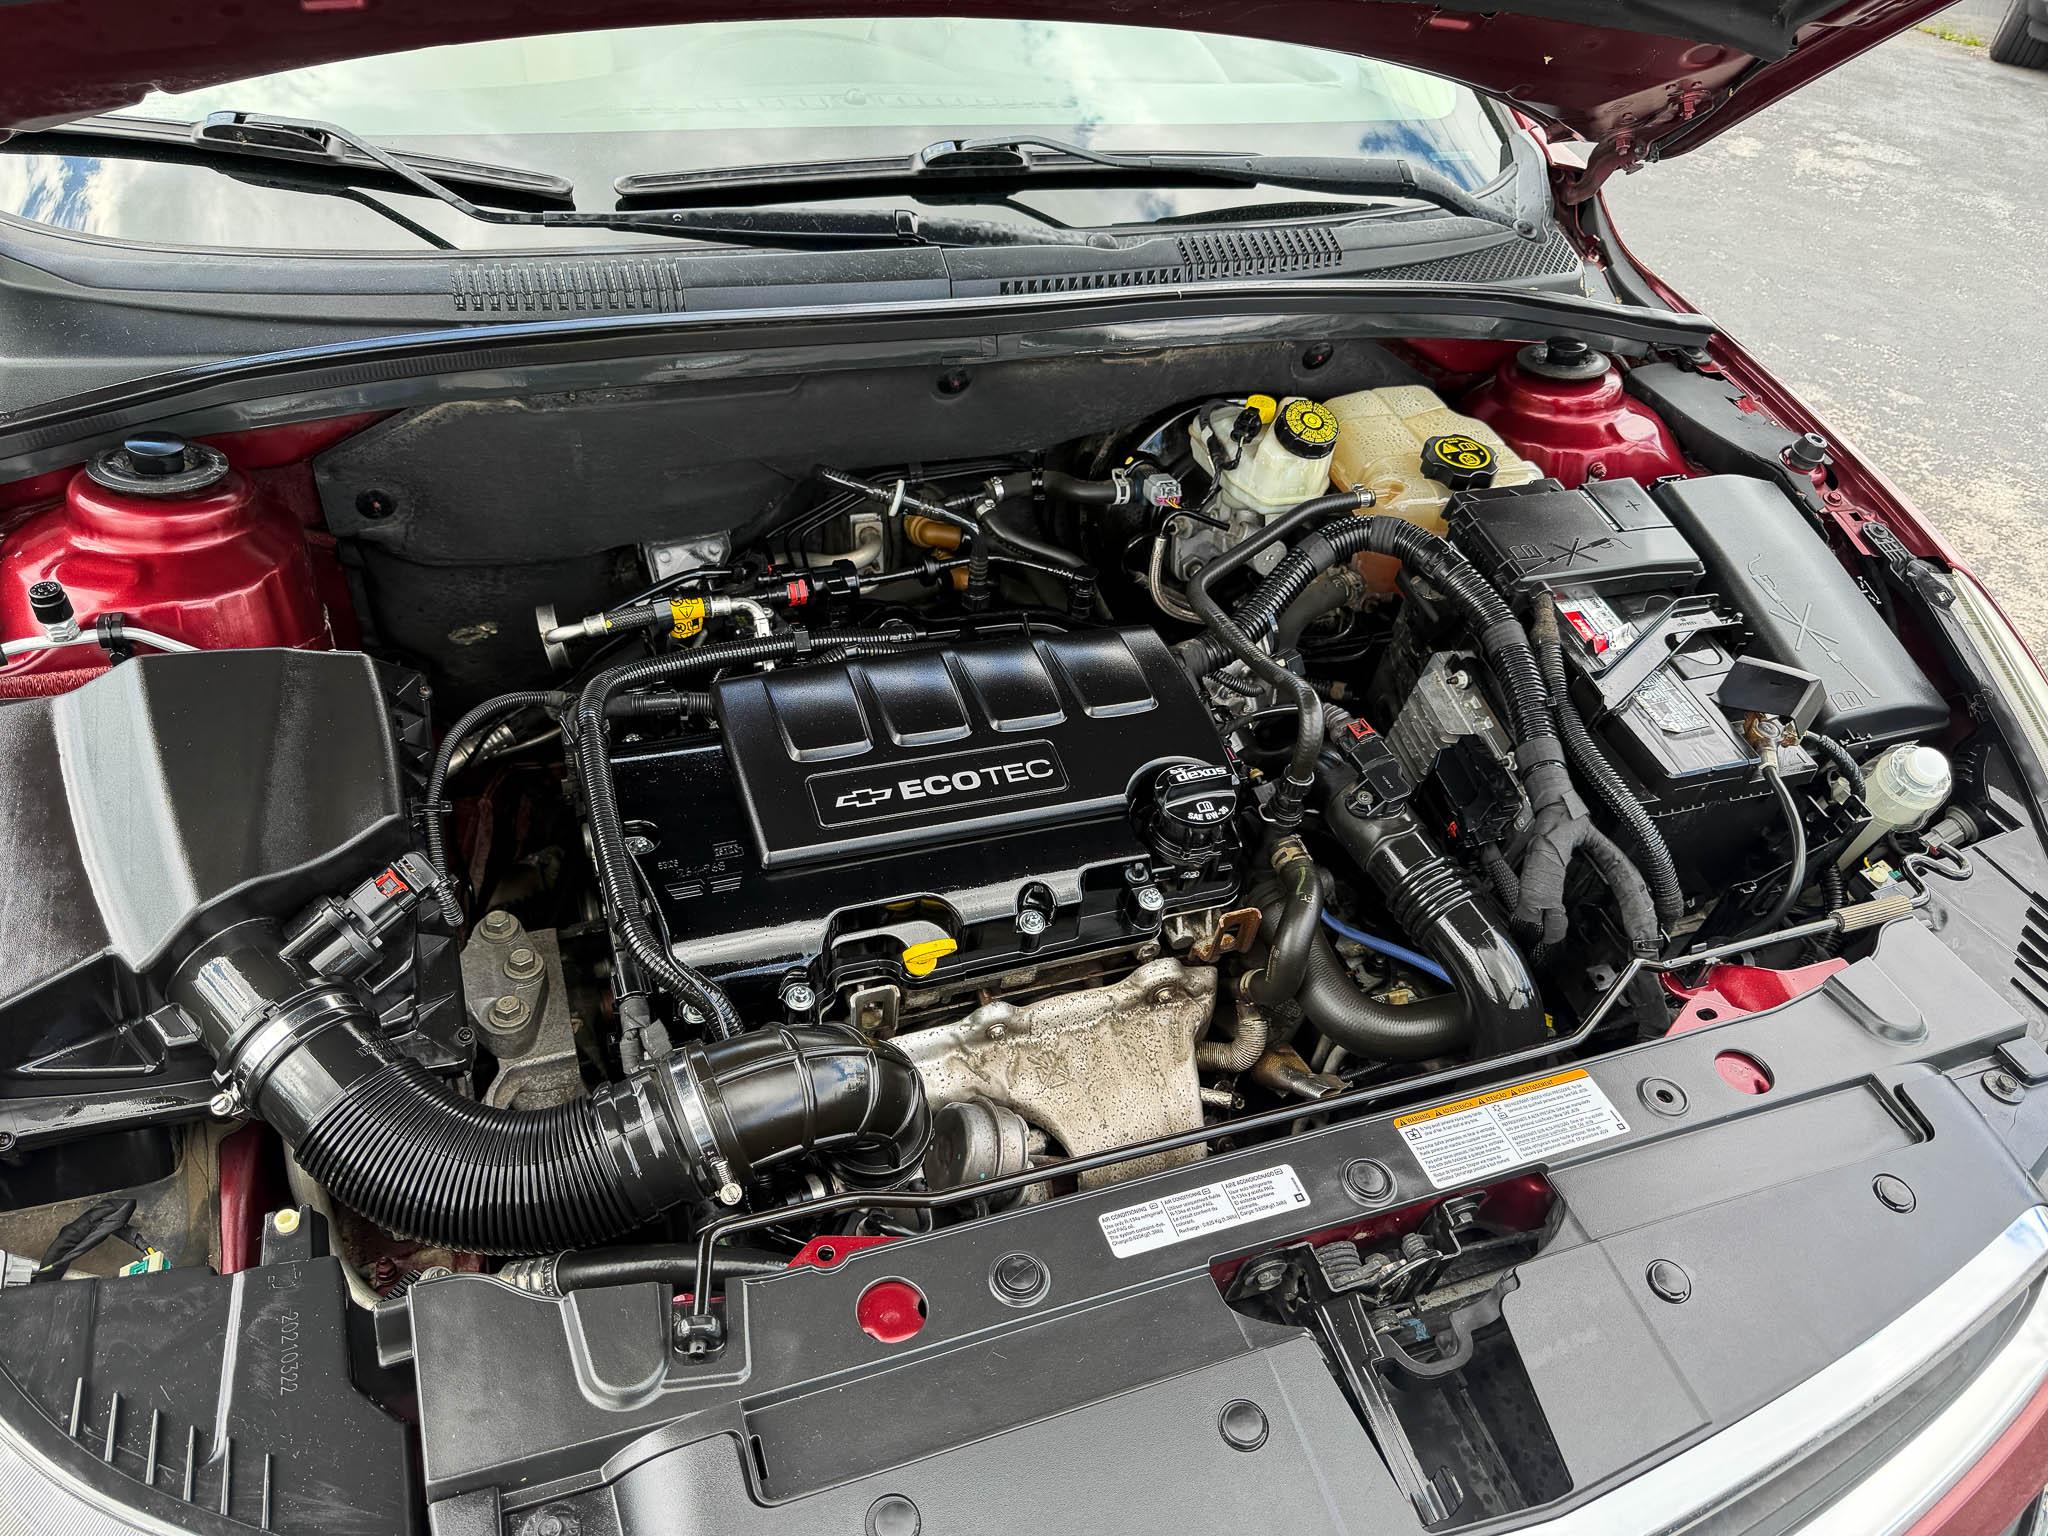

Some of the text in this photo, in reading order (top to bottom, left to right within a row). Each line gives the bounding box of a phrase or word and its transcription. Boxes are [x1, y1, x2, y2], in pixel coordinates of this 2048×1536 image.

[898, 759, 1053, 800] ECOTEC
[1176, 767, 1227, 782] dexos
[1188, 813, 1204, 821] SAE
[1405, 1112, 1431, 1123] WARNING
[1110, 1206, 1147, 1220] CONDITIONING
[281, 1311, 299, 1396] 20210322
